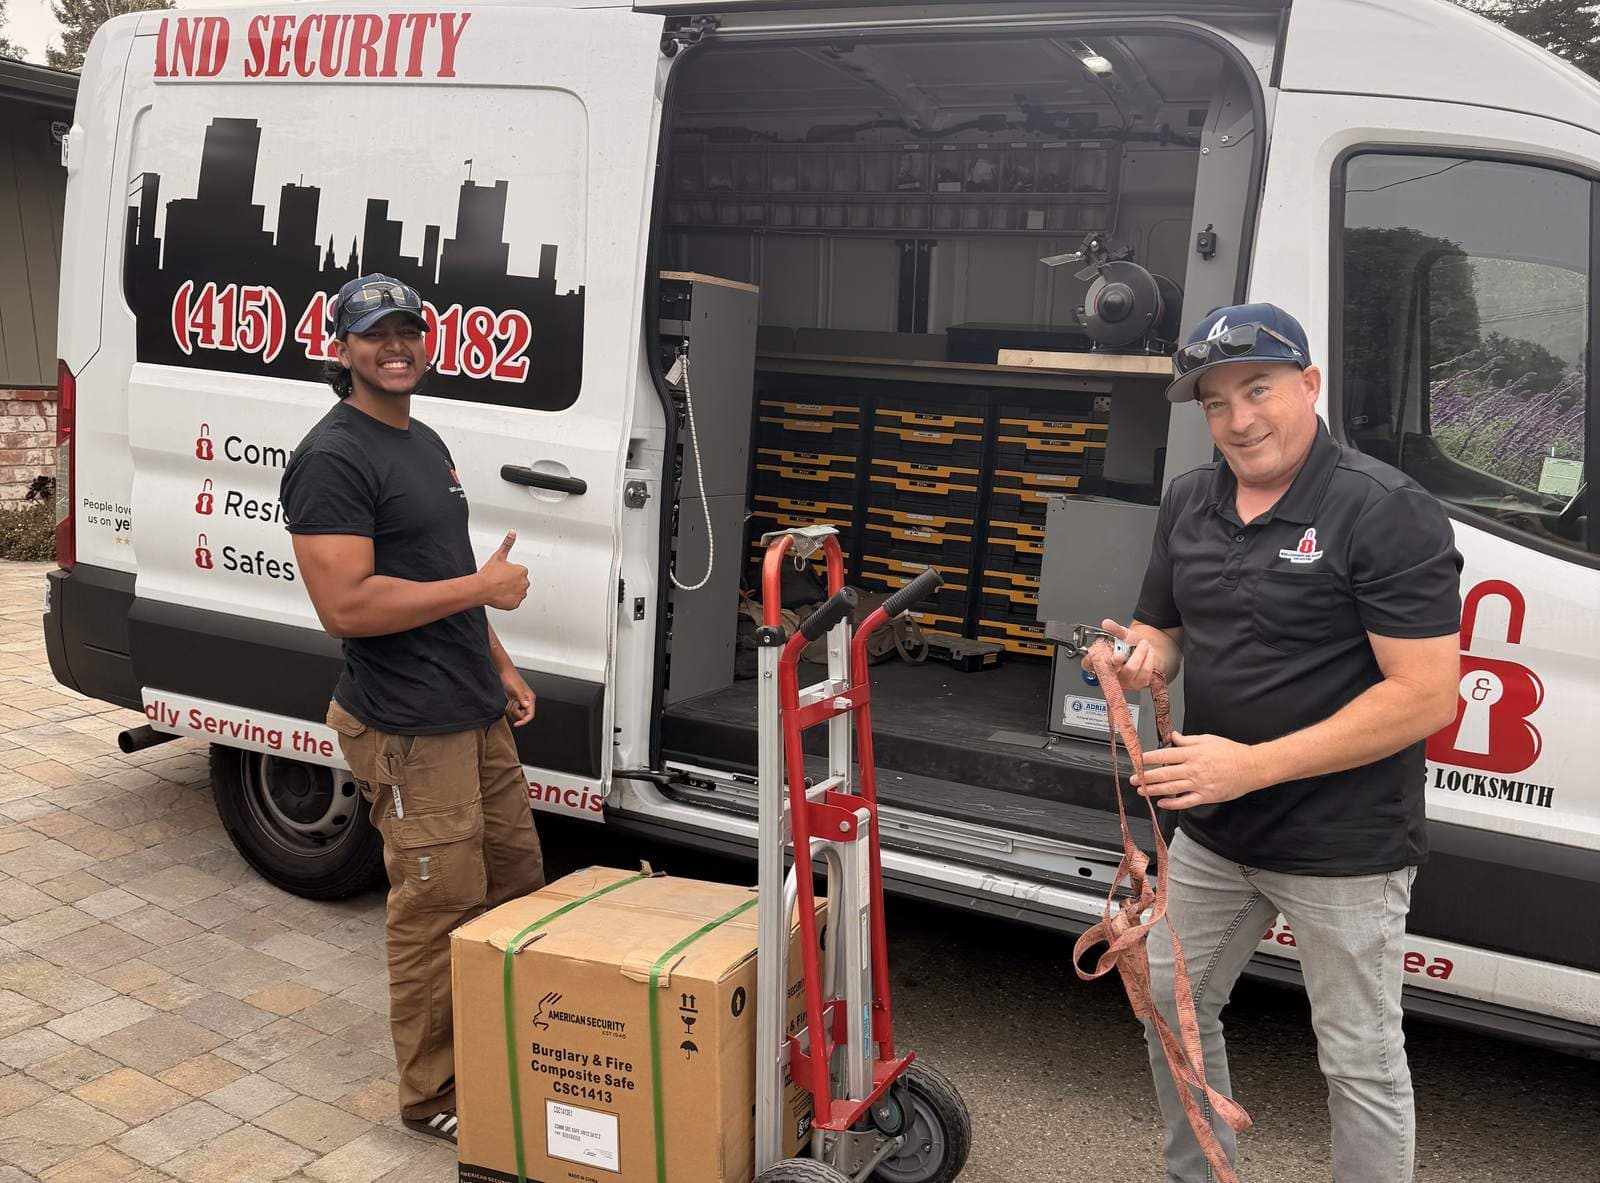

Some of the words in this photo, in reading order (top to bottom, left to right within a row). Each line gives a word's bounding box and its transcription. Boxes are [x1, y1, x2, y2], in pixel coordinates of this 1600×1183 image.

[244, 13, 472, 77] SECURITY
[172, 280, 286, 364] (415)
[224, 435, 294, 468] Com
[83, 498, 113, 512] People
[88, 515, 98, 524] us
[100, 517, 112, 527] on
[222, 545, 295, 581] Safes
[144, 700, 181, 728] dly
[188, 708, 283, 750] Serving
[292, 731, 334, 758] the
[527, 781, 604, 813] ancis
[1433, 767, 1555, 809] LOCKSMITH
[548, 1010, 587, 1026] AMERICAN
[587, 1016, 625, 1033] SECURITY
[532, 1042, 589, 1067] Burglary
[592, 1054, 603, 1067] &
[605, 1056, 634, 1073] Fire
[531, 1059, 602, 1085] Composite
[604, 1073, 636, 1091] Safe
[552, 1080, 613, 1104] CSC1413
